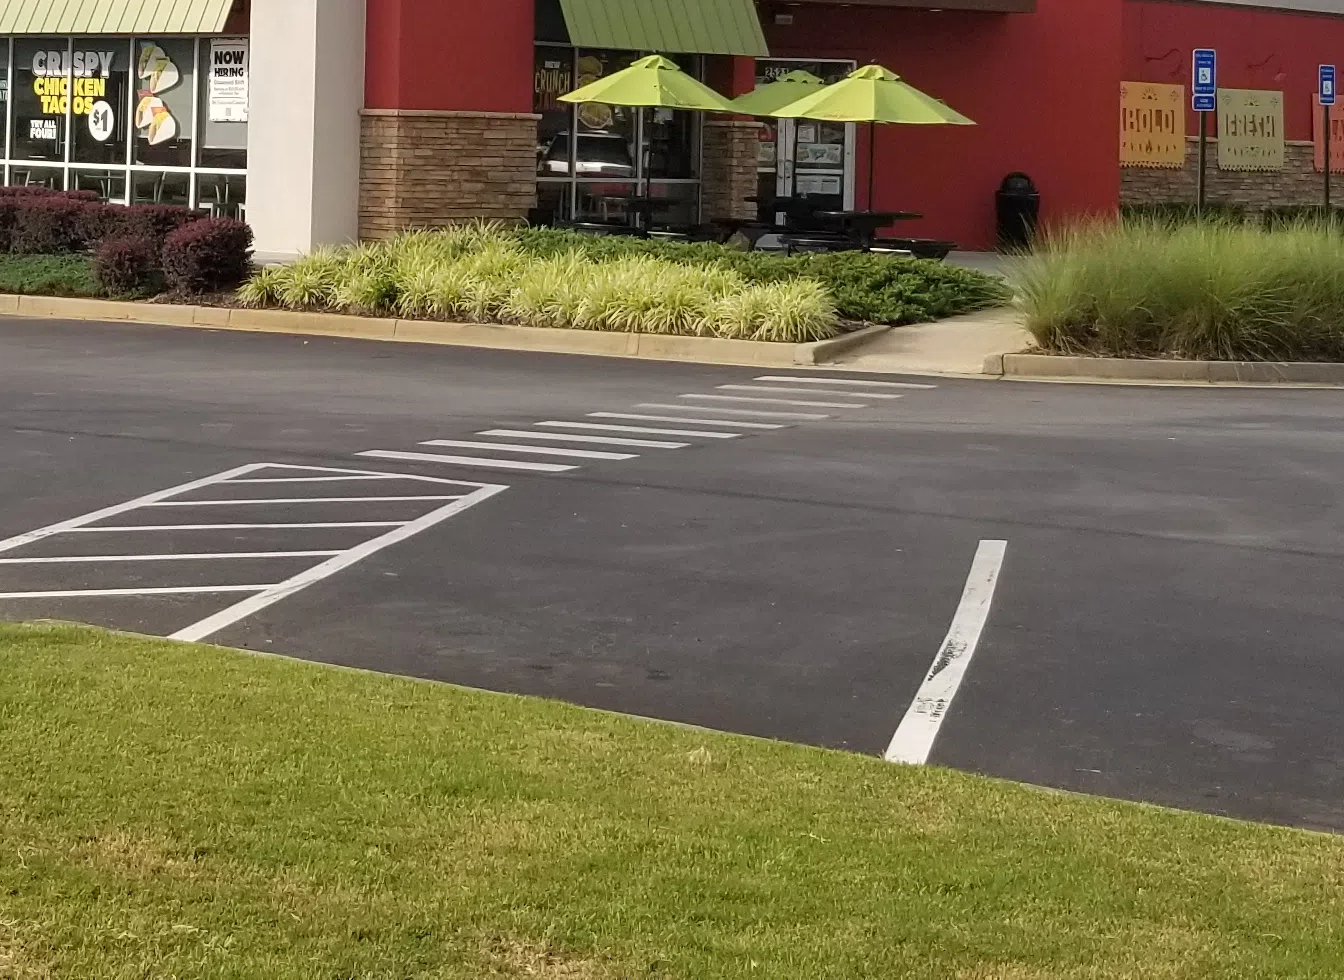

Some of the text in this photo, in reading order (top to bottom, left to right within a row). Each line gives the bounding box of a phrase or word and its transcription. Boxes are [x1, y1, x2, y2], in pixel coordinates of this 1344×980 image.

[32, 50, 114, 78] CRISPY
[214, 51, 245, 65] NOW
[214, 67, 244, 77] HIRING
[34, 77, 106, 97] CHICKEN
[41, 95, 94, 115] TACOS
[93, 109, 108, 132] $1
[1122, 108, 1175, 134] BOLD
